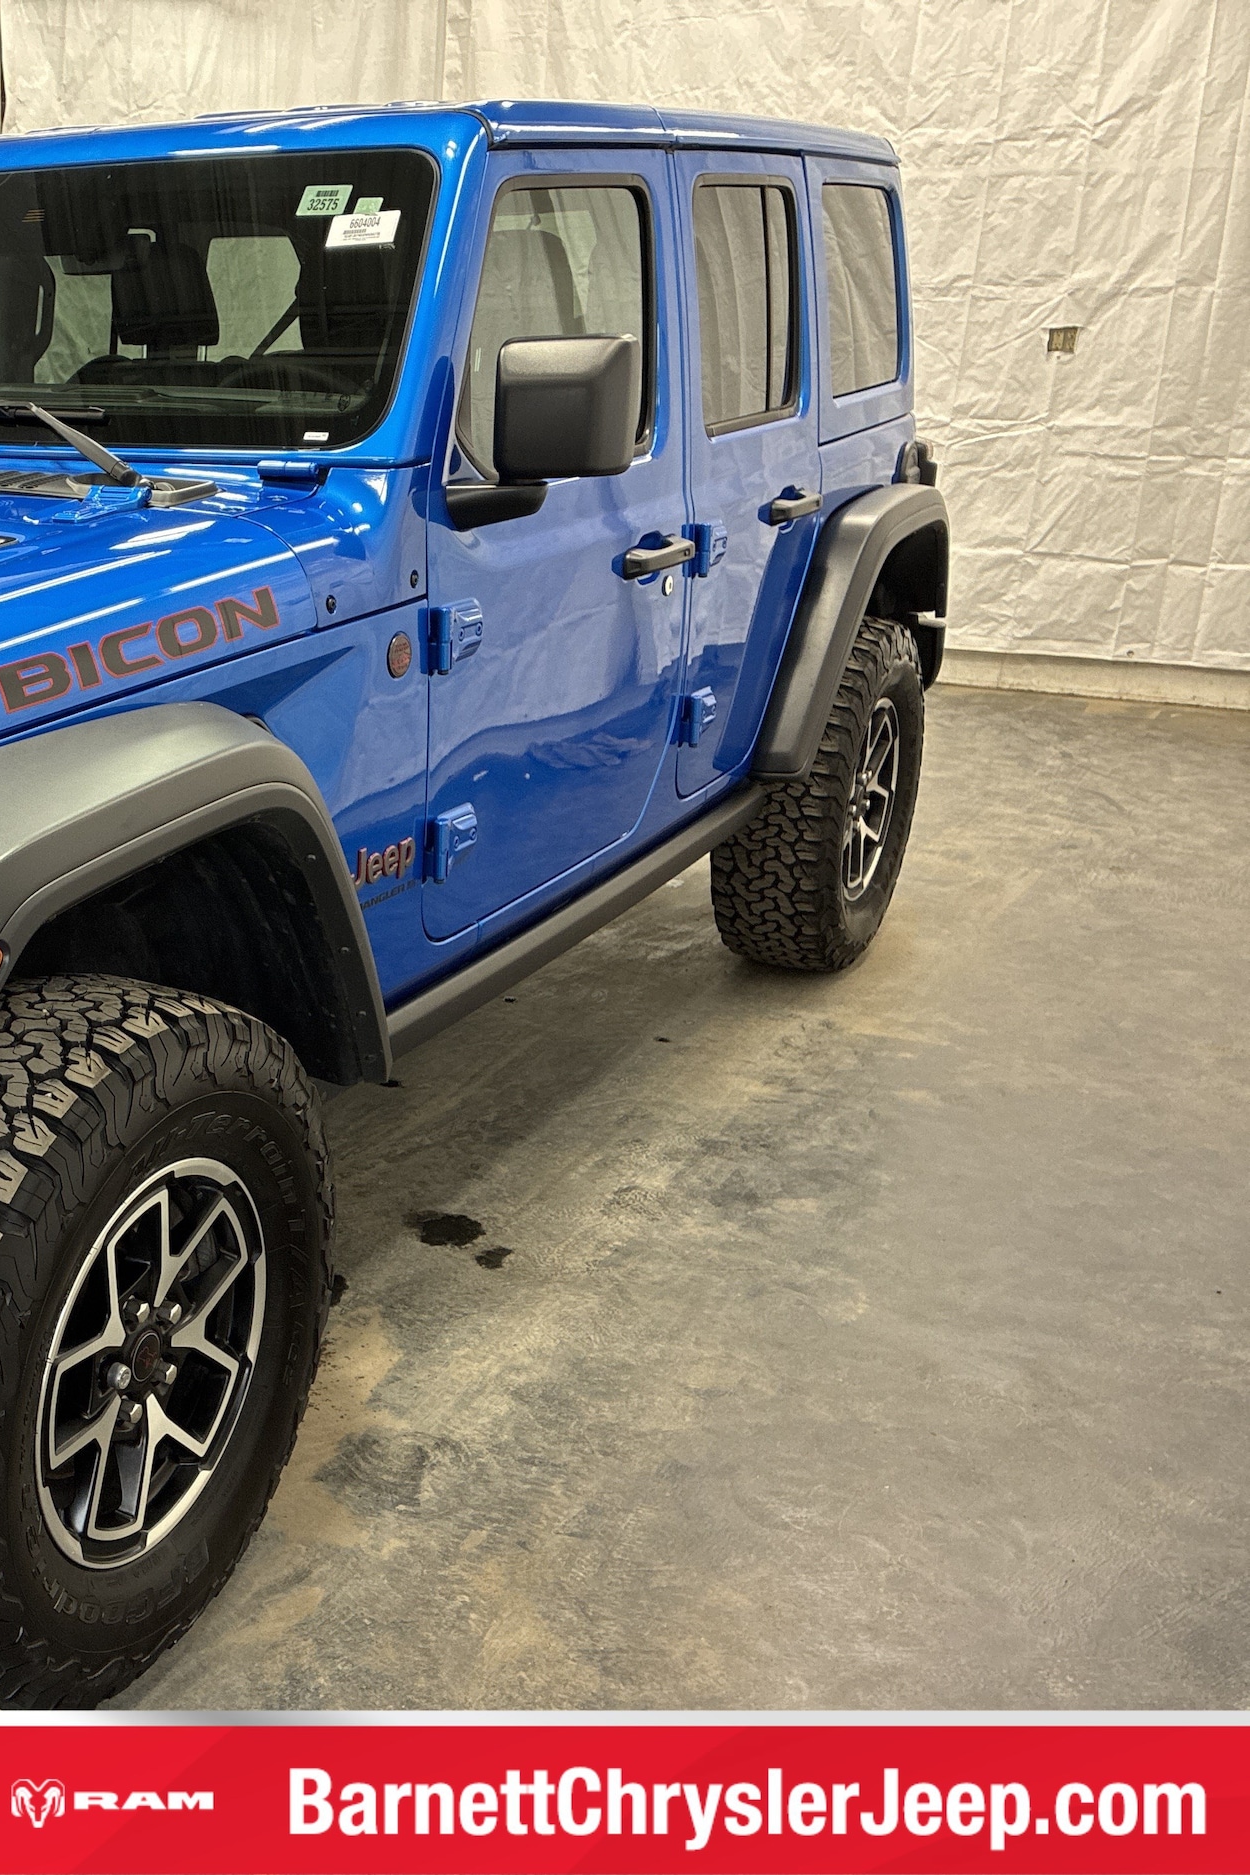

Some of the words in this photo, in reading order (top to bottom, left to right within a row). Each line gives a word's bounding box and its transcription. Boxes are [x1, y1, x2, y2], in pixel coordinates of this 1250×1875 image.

[307, 198, 339, 211] 32575
[353, 836, 416, 889] Jeep
[360, 883, 405, 911] ANGLER
